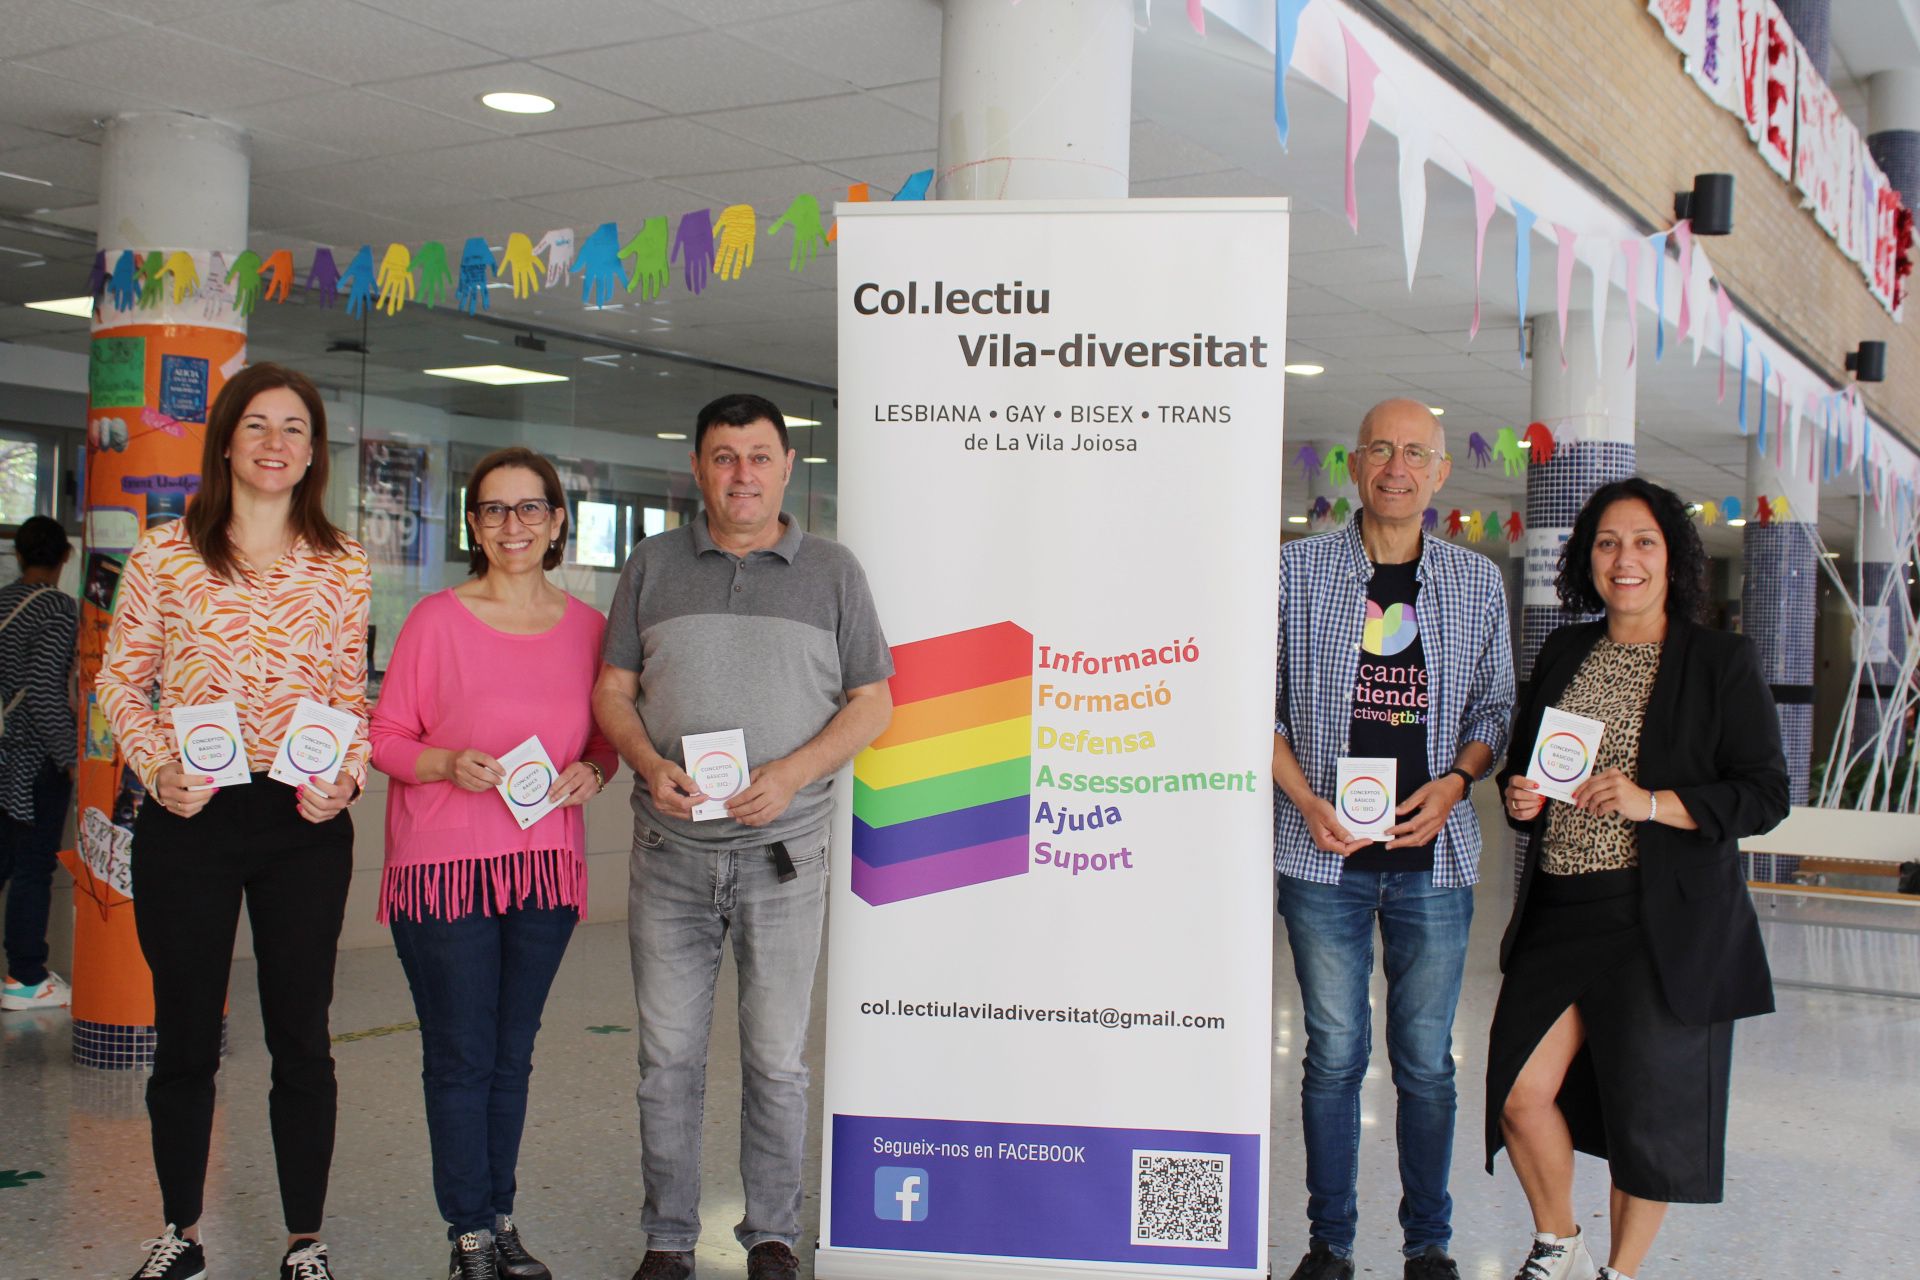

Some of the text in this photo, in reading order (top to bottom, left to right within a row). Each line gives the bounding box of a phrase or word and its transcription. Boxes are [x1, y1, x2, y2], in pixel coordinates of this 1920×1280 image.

[853, 281, 1050, 316] Col.lectiu
[957, 332, 1268, 368] Vila-diversitat
[874, 404, 1232, 424] LESBIANA GAY BISEX TRANS
[964, 433, 1138, 452] de La Vila Joiosa
[1038, 636, 1200, 676] Informació
[1357, 664, 1428, 686] cante
[1038, 680, 1172, 713] Formació
[1354, 682, 1429, 708] tiende
[1353, 707, 1428, 726] ctivolgtbi+
[1037, 725, 1157, 755] Defensa
[1035, 765, 1258, 794] Assessorament
[1034, 802, 1123, 835] Ajuda
[1034, 842, 1134, 876] Suport
[860, 999, 1225, 1030] col.lectiulaviladiversitat@gmail.com
[873, 1136, 1086, 1163] Segueix-nos en FACEBOOK
